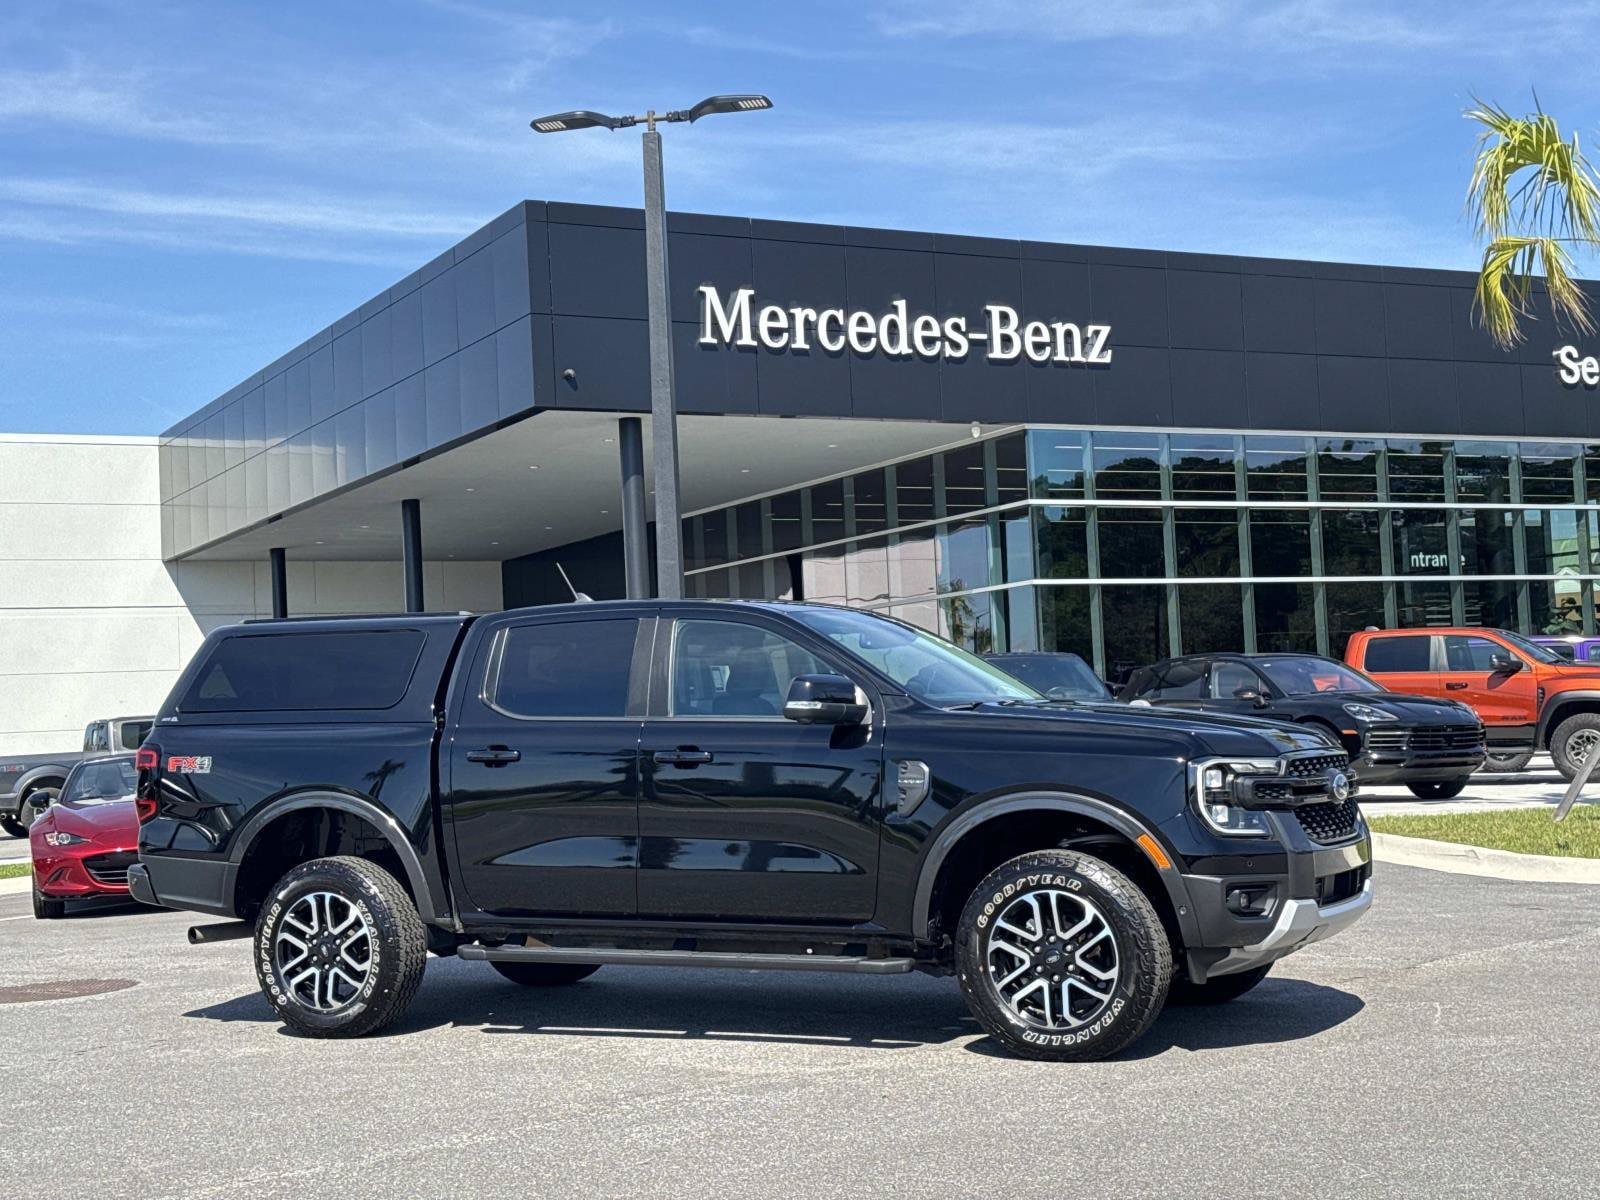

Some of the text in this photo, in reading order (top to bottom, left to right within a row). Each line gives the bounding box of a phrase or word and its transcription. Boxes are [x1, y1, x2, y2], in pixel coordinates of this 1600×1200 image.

[699, 286, 1112, 364] Mercedes-Benz
[1411, 551, 1466, 568] ntrane
[167, 756, 212, 772] FX4
[977, 873, 1082, 928] GOODYEAR
[261, 902, 287, 1005] GOODYEAR
[356, 899, 380, 998] WRANGLER
[1022, 997, 1125, 1046] WRANGLER
